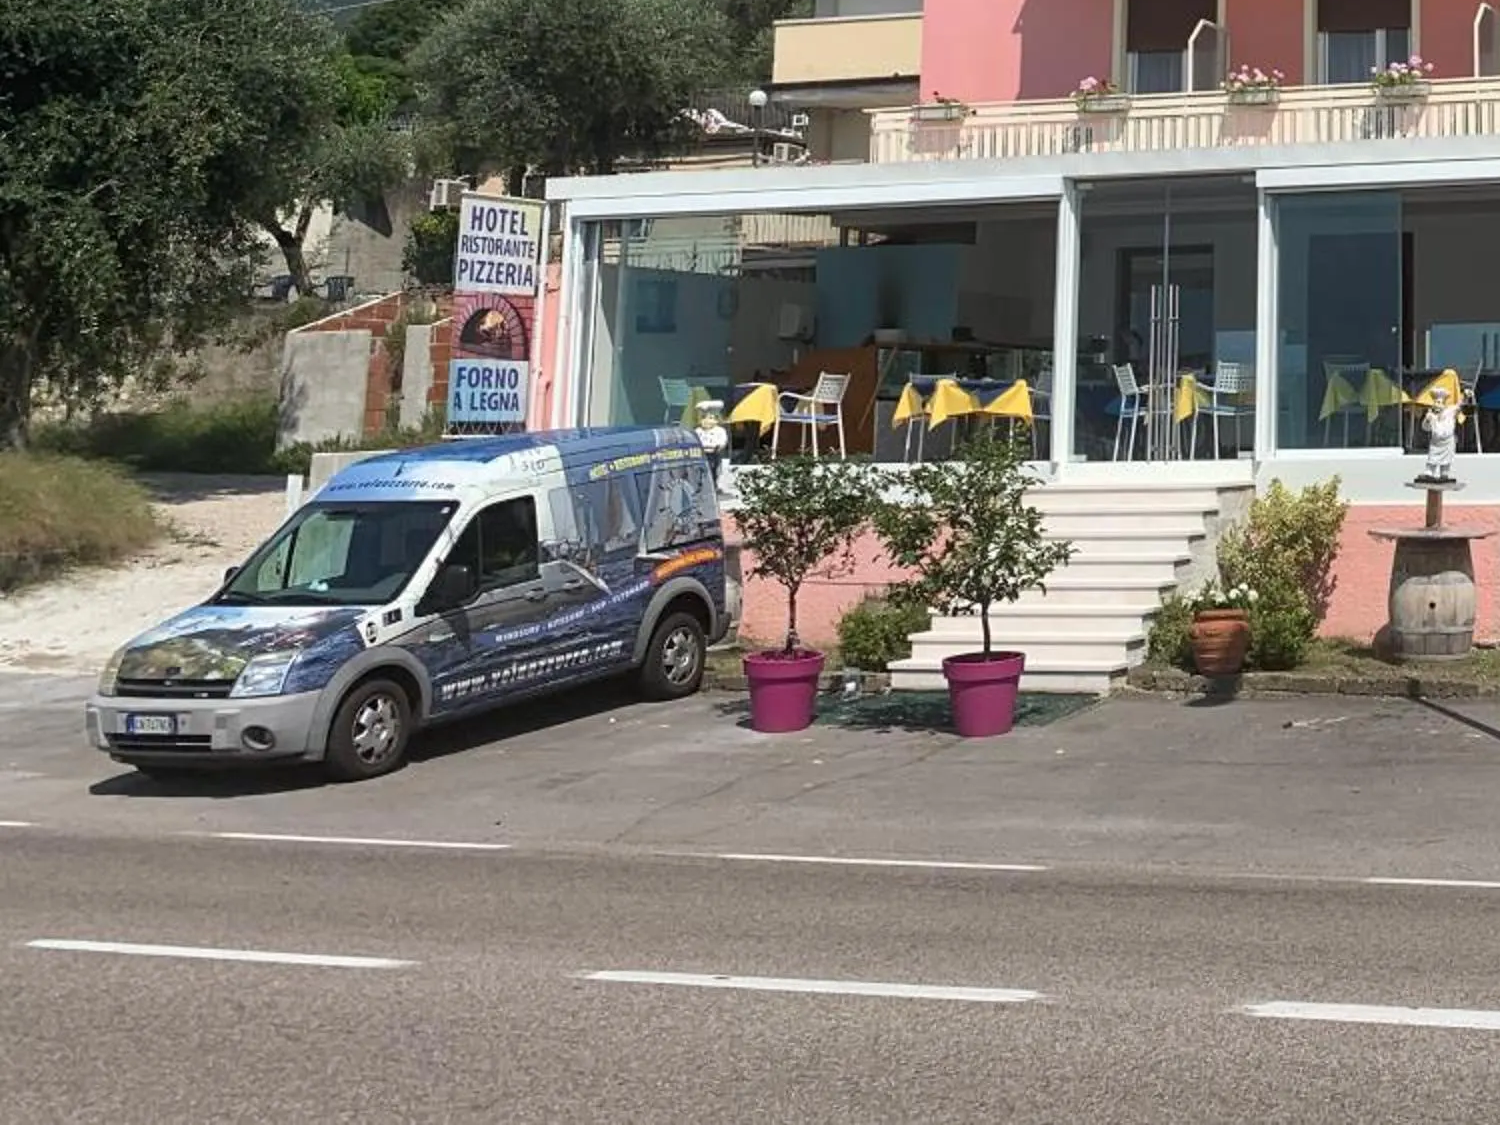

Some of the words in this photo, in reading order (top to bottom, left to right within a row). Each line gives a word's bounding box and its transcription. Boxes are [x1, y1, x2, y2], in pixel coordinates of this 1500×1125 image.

[471, 206, 529, 236] HOTEL
[461, 235, 536, 260] RISTORANTE
[458, 260, 534, 287] PIZZERIA
[456, 366, 519, 390] FORNO
[453, 393, 463, 411] A
[471, 391, 520, 412] LEGNA
